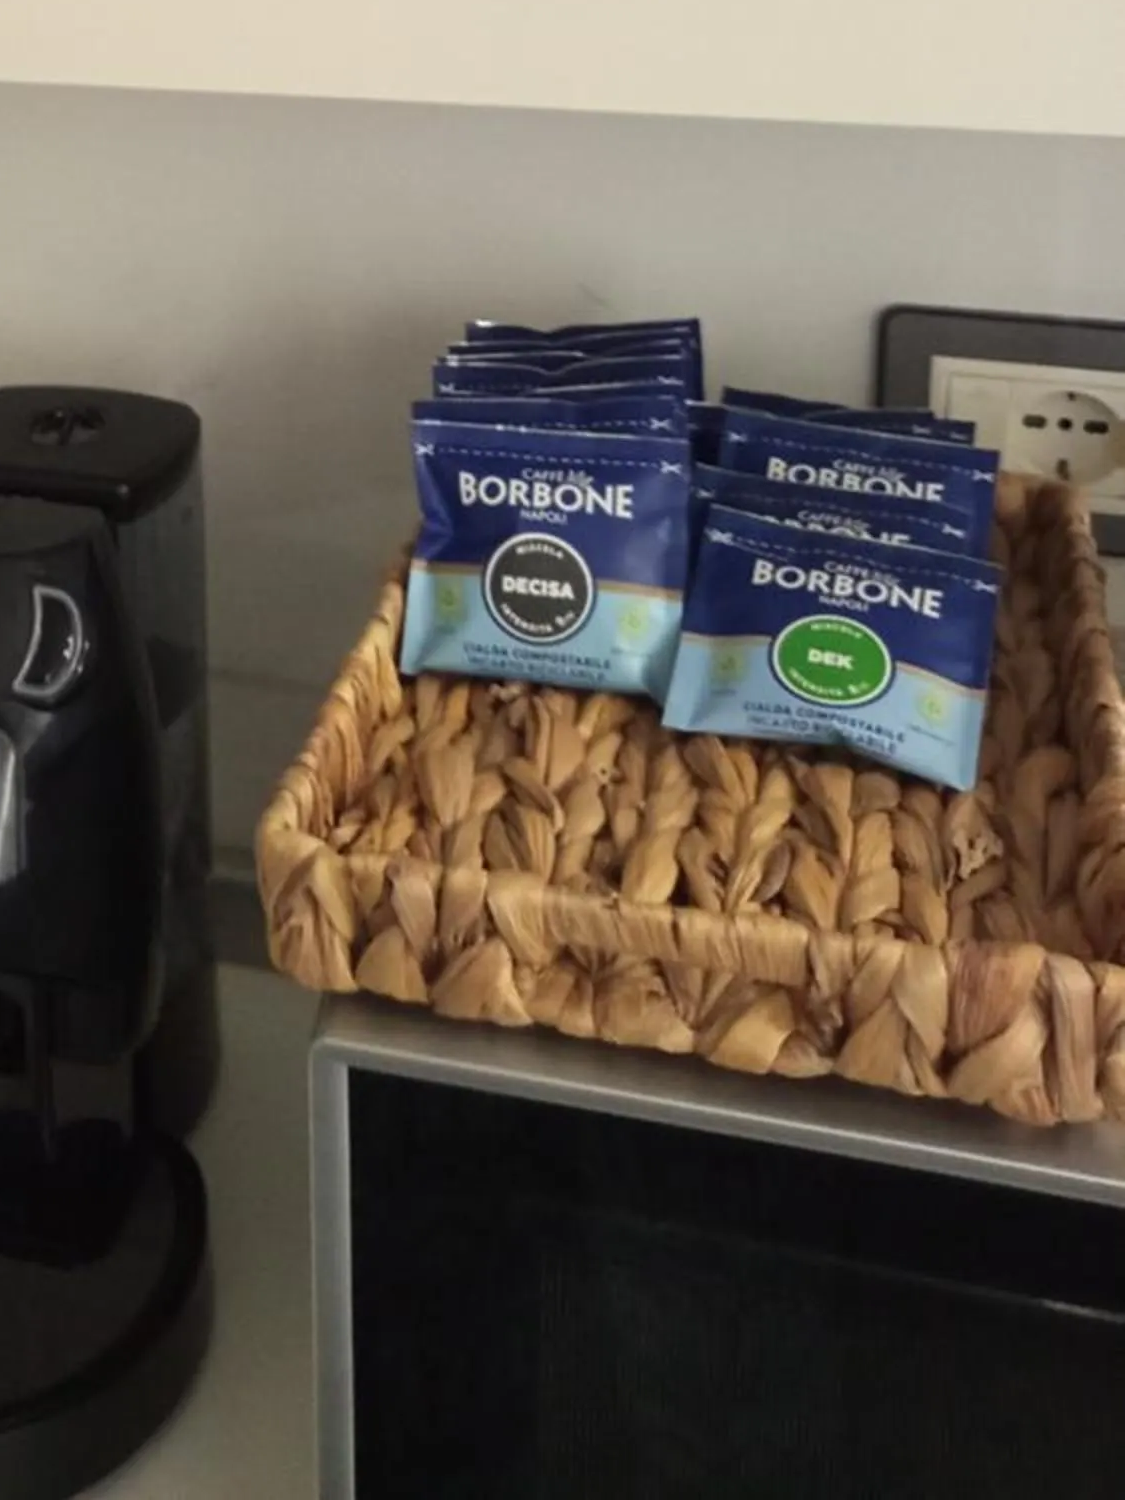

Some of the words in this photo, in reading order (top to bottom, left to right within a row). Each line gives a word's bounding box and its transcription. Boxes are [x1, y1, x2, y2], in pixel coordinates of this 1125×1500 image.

[458, 470, 635, 521] BORBONE
[501, 574, 575, 601] DECISA
[751, 558, 944, 619] BORBONE
[807, 647, 854, 671] DEK
[742, 700, 792, 716] CIALDA
[795, 706, 905, 744] COMPOSTABILE
